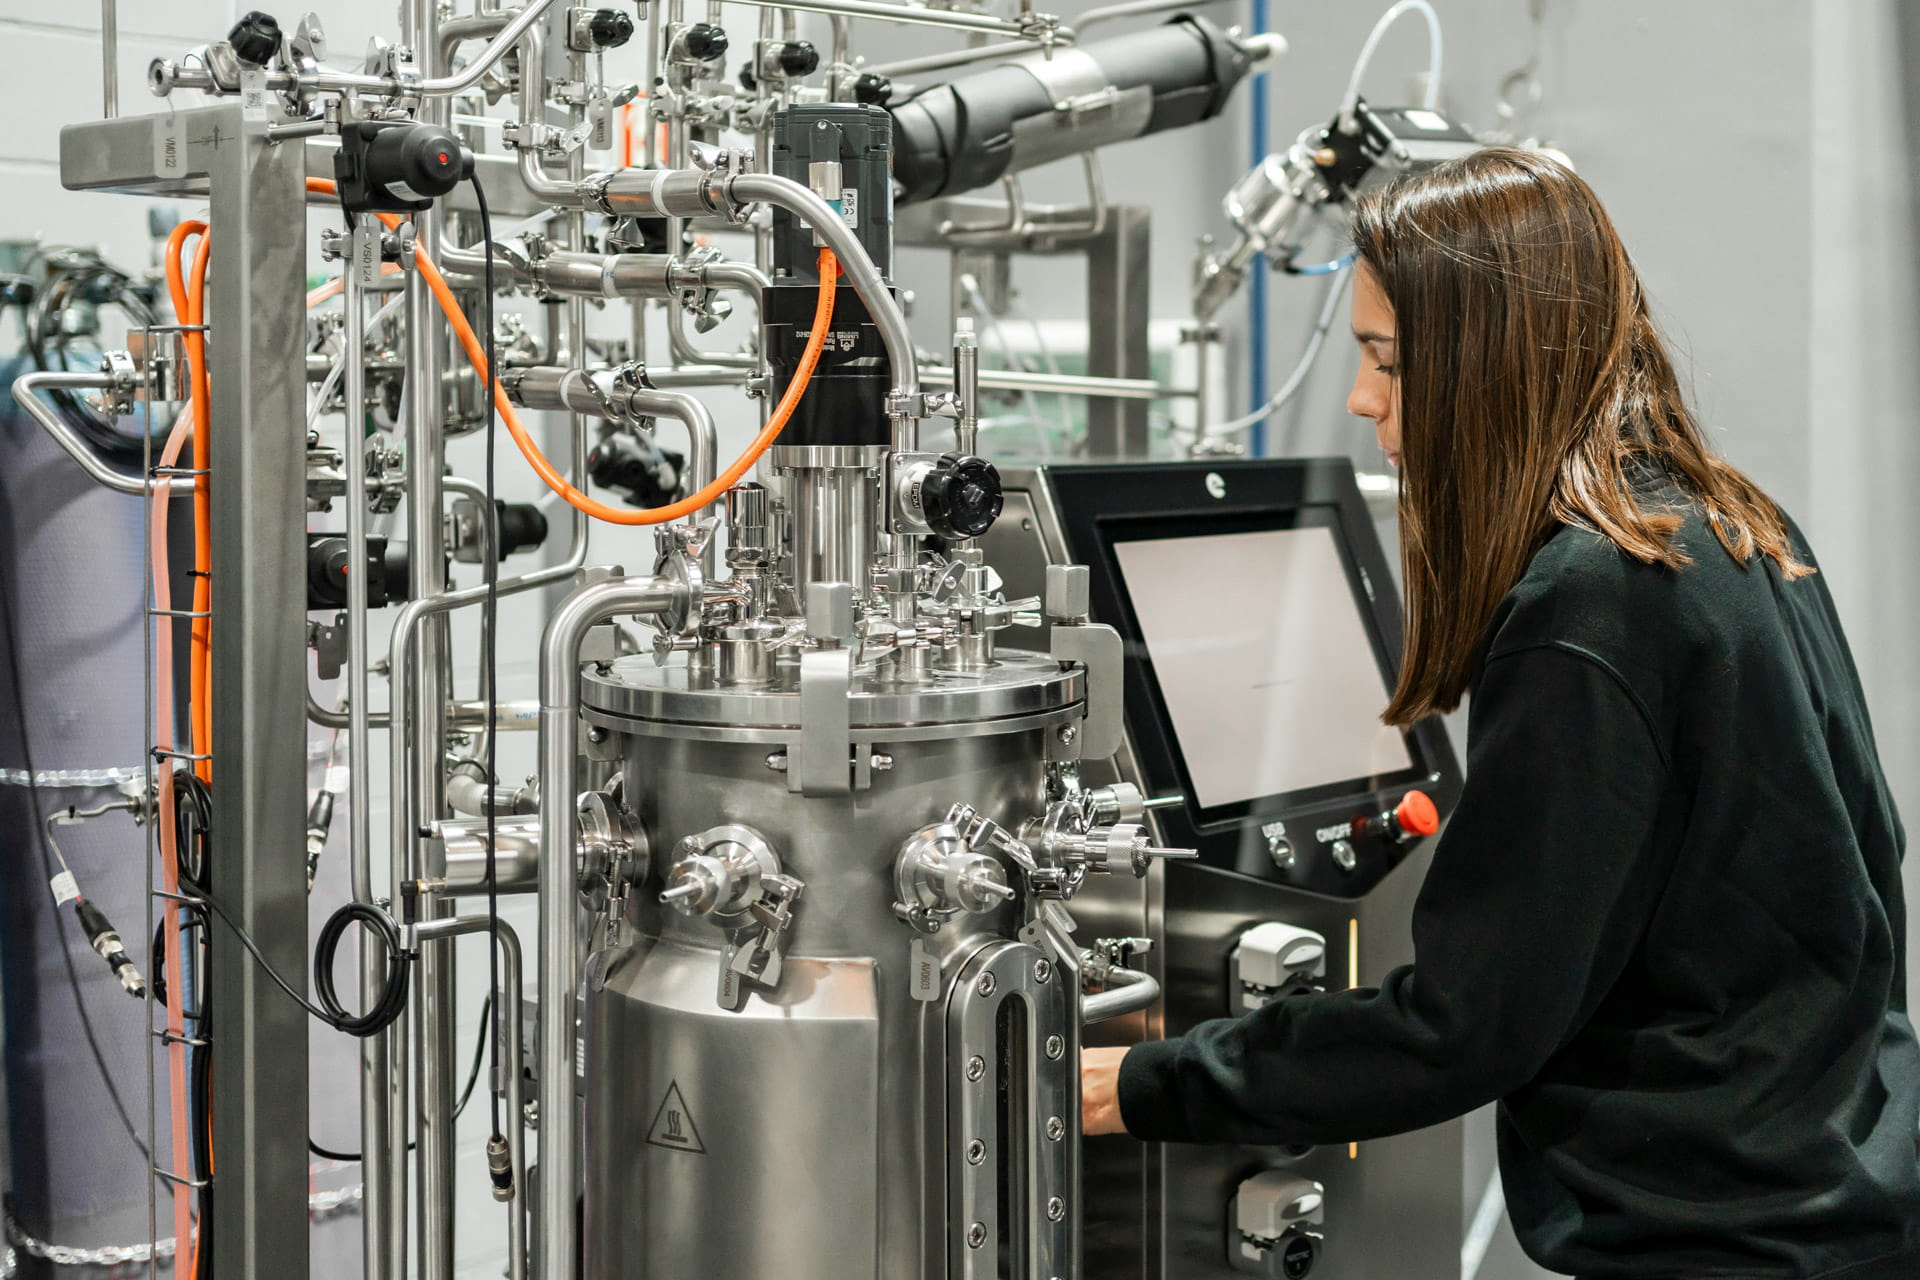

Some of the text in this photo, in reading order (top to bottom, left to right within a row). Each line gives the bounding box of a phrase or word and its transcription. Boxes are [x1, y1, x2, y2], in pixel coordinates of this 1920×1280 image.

[165, 137, 176, 168] VM0122
[912, 483, 921, 510] EPDM
[1262, 821, 1286, 838] USB
[1316, 823, 1352, 843] ON/OFF
